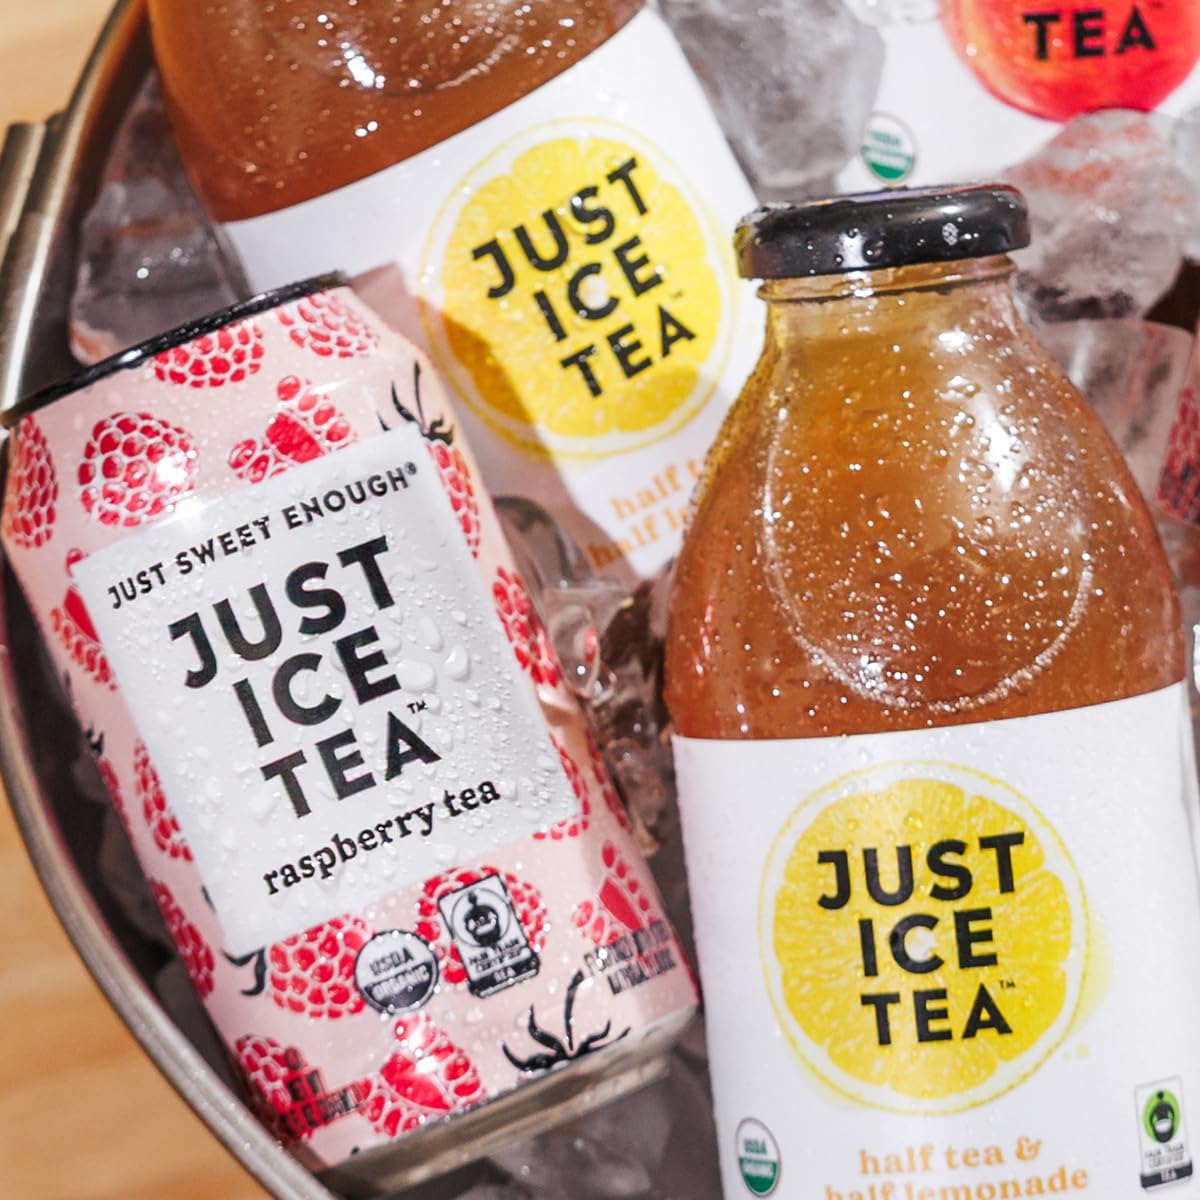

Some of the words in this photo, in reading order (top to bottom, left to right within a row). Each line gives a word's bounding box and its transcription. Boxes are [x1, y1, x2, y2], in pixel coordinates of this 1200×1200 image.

[471, 157, 649, 300] JUST
[532, 234, 665, 343] ICE
[610, 463, 683, 519] half
[106, 562, 167, 610] JUST
[175, 516, 272, 576] SWEET
[168, 535, 396, 689] JUST
[232, 625, 402, 749] ICE
[262, 801, 436, 896] raspberry
[443, 780, 502, 818] tea
[816, 831, 1026, 911] JUST
[858, 907, 999, 978] ICE
[859, 1142, 934, 1175] half
[945, 1143, 1004, 1170] tea
[1015, 1136, 1042, 1162] &
[904, 1164, 1089, 1200] lemonade
